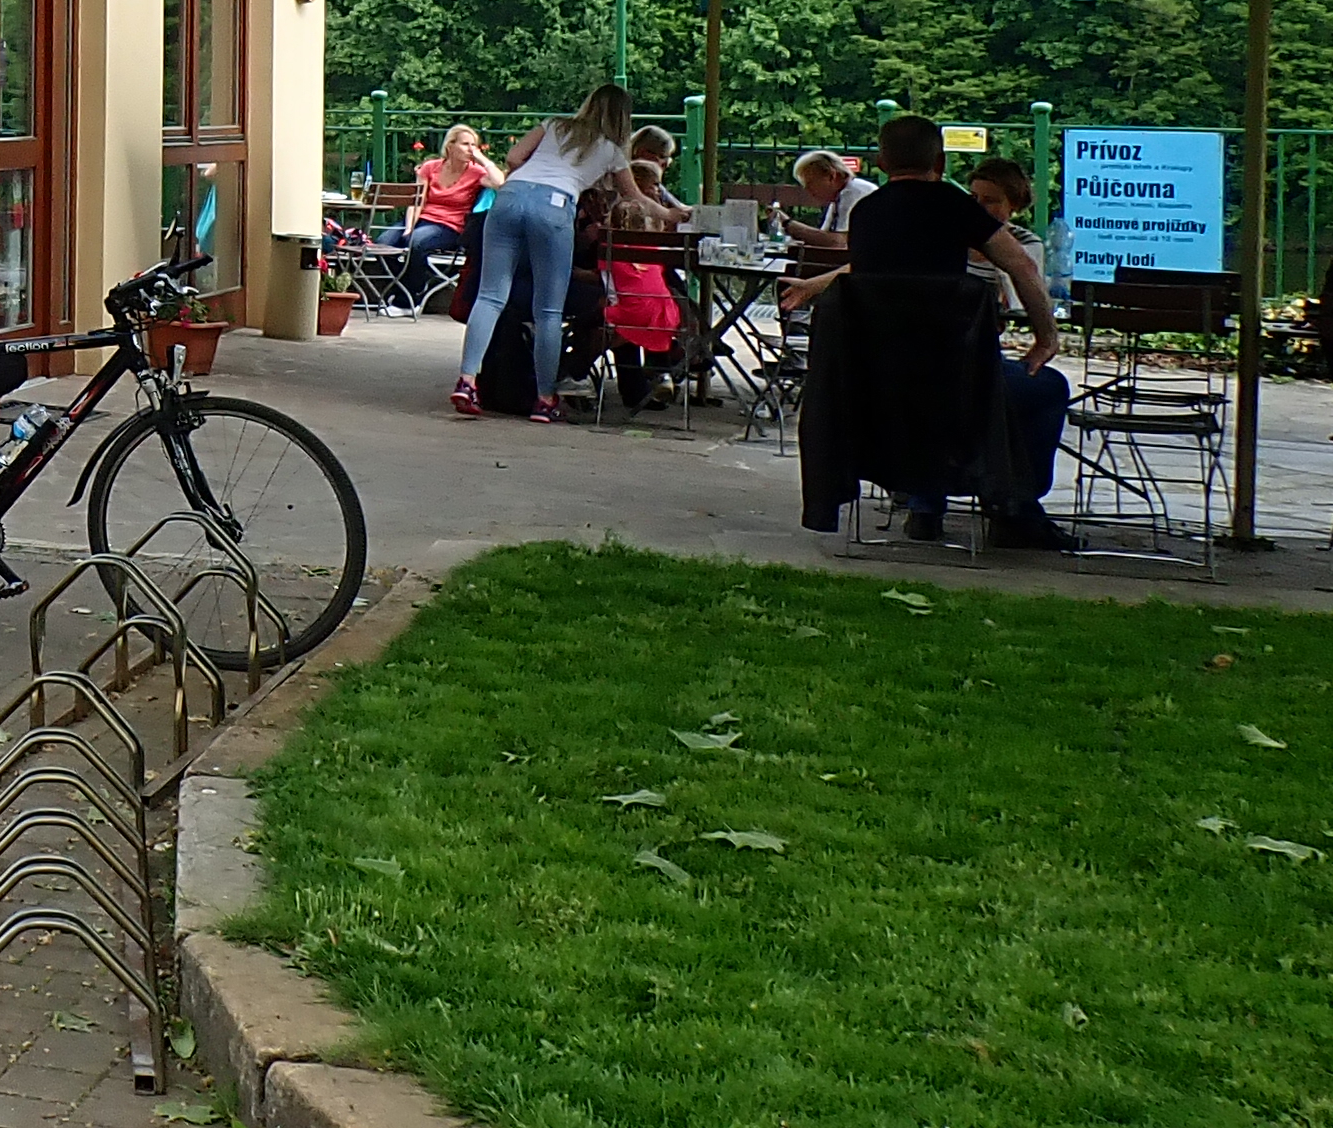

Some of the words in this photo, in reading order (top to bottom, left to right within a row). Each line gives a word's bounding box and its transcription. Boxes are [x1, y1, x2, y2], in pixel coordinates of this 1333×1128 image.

[1076, 139, 1142, 161] Přívoz
[1076, 175, 1175, 199] Půjčovna
[1075, 216, 1139, 230] Hodinové
[1075, 251, 1123, 266] Plavby
[1127, 252, 1155, 267] lodí
